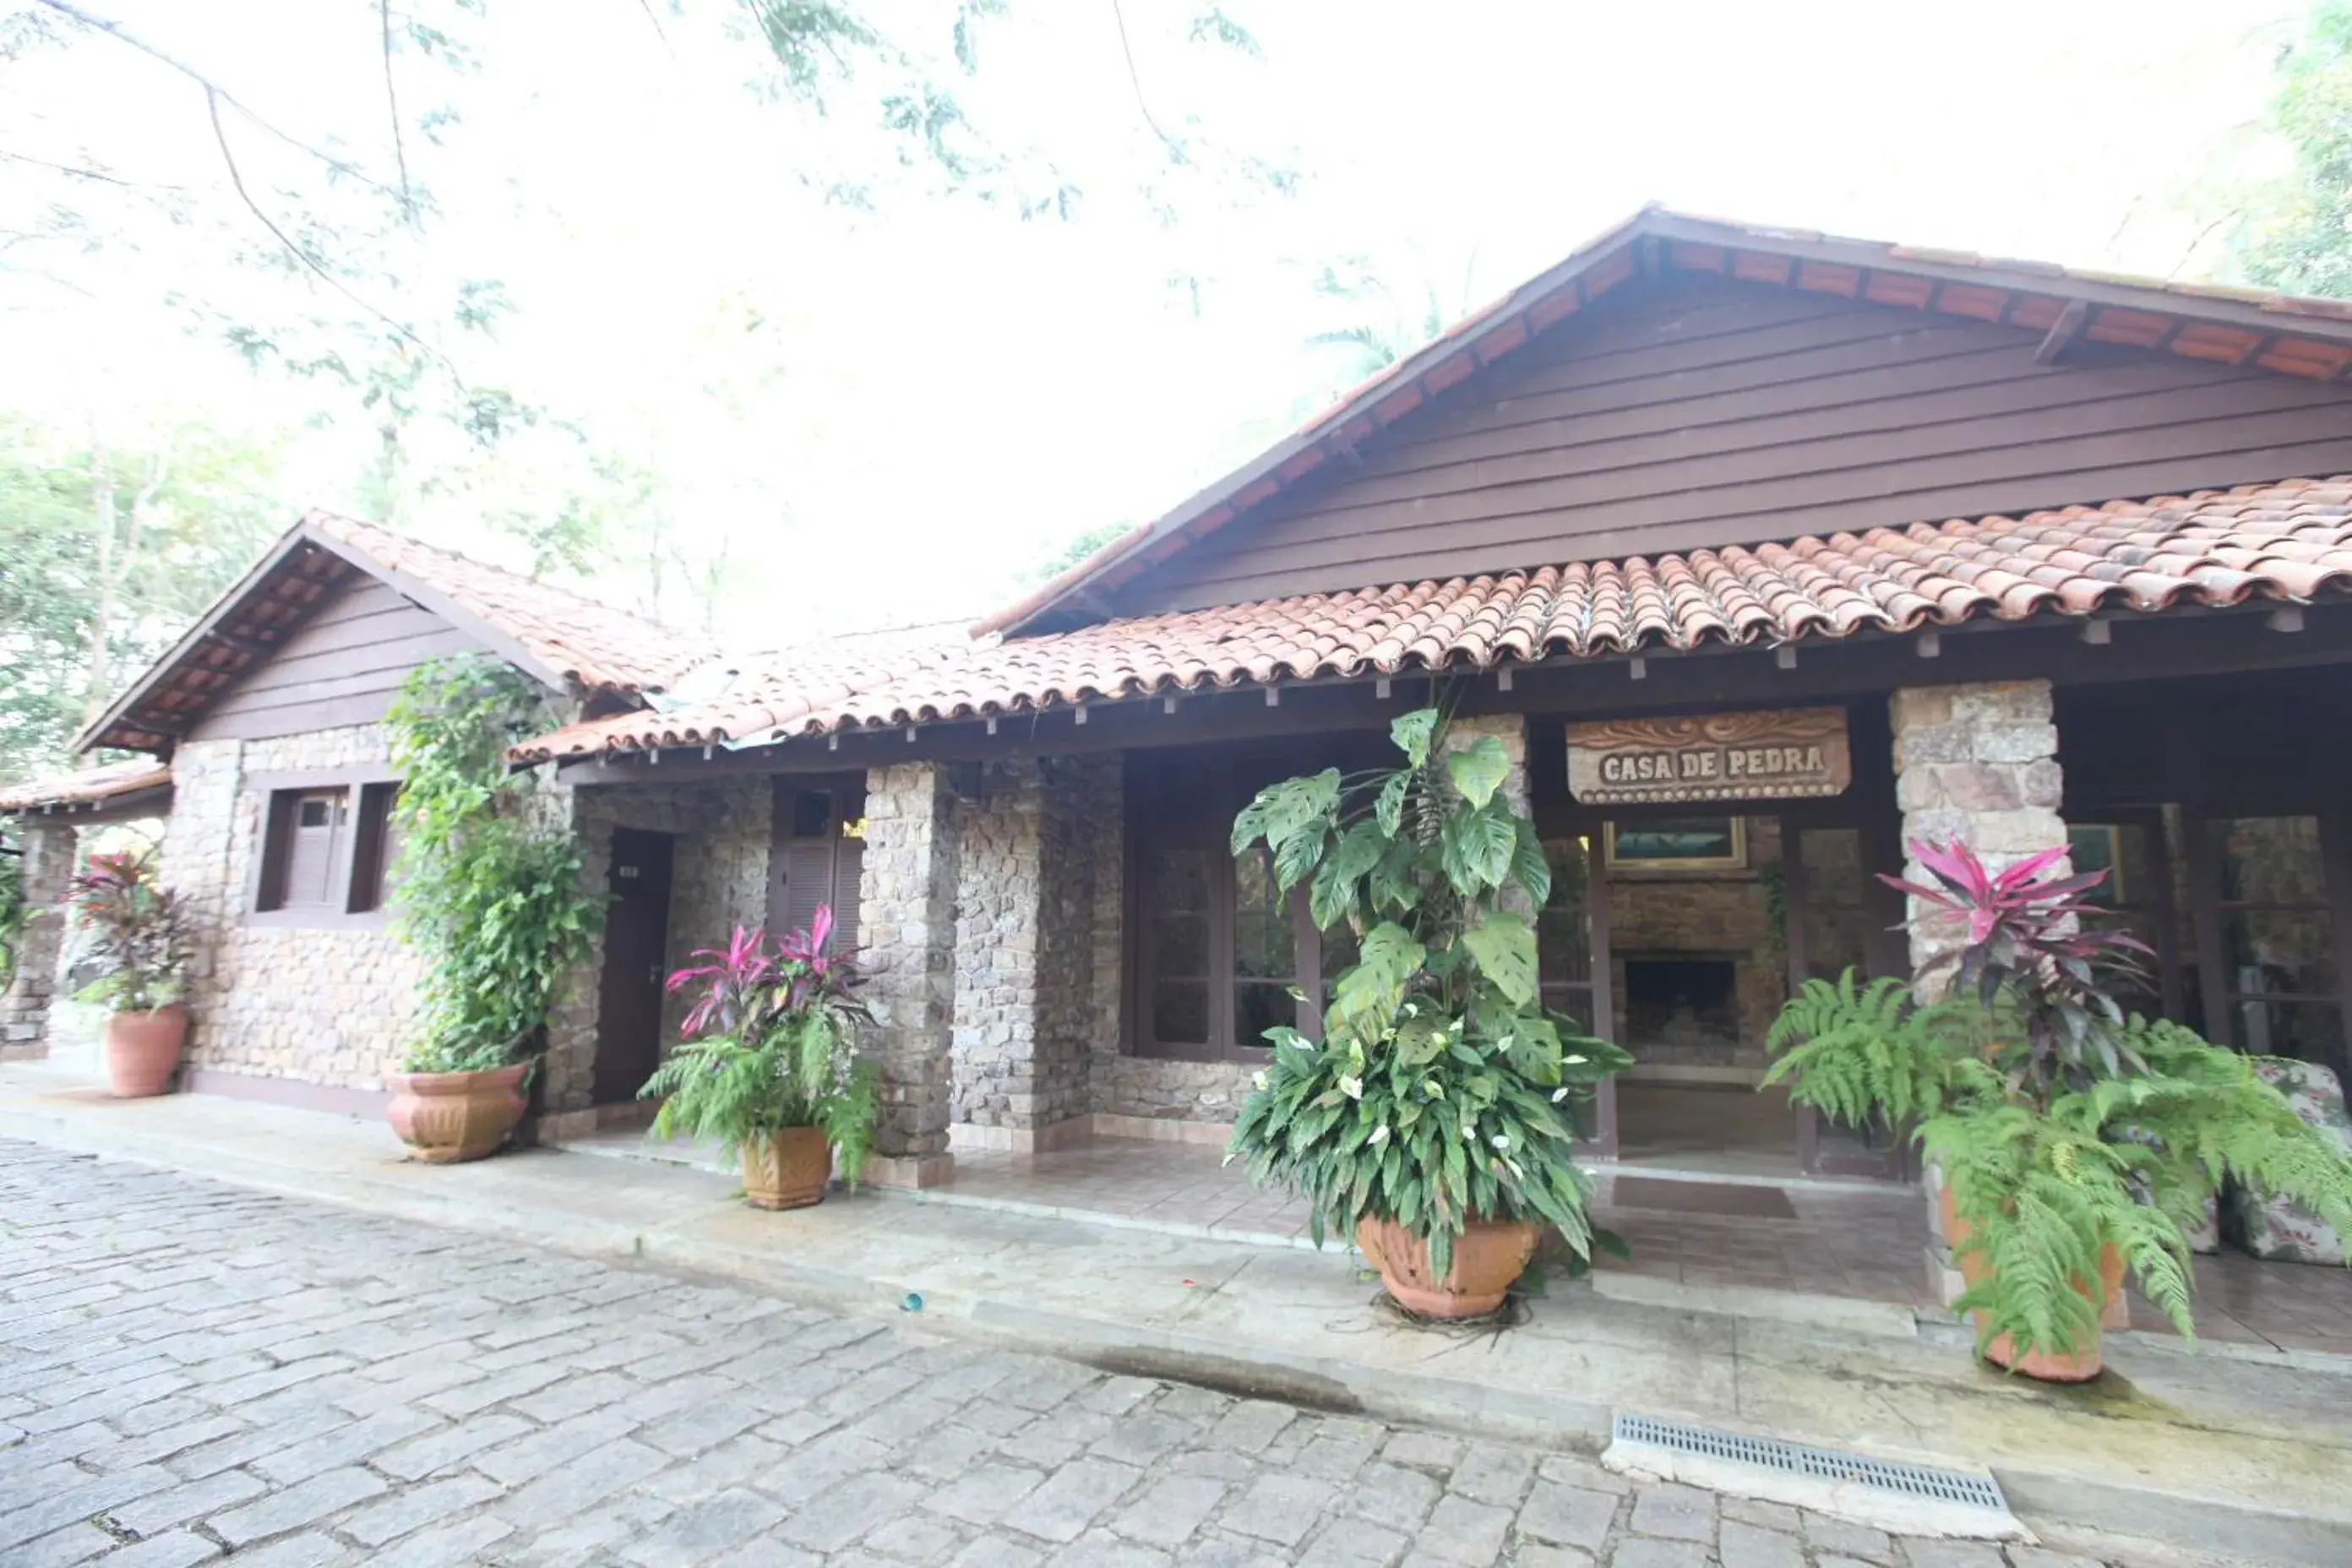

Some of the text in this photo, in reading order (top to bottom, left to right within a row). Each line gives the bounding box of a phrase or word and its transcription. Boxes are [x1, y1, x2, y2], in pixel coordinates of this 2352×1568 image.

[1604, 746, 1826, 781] CASA DE PEDRA
